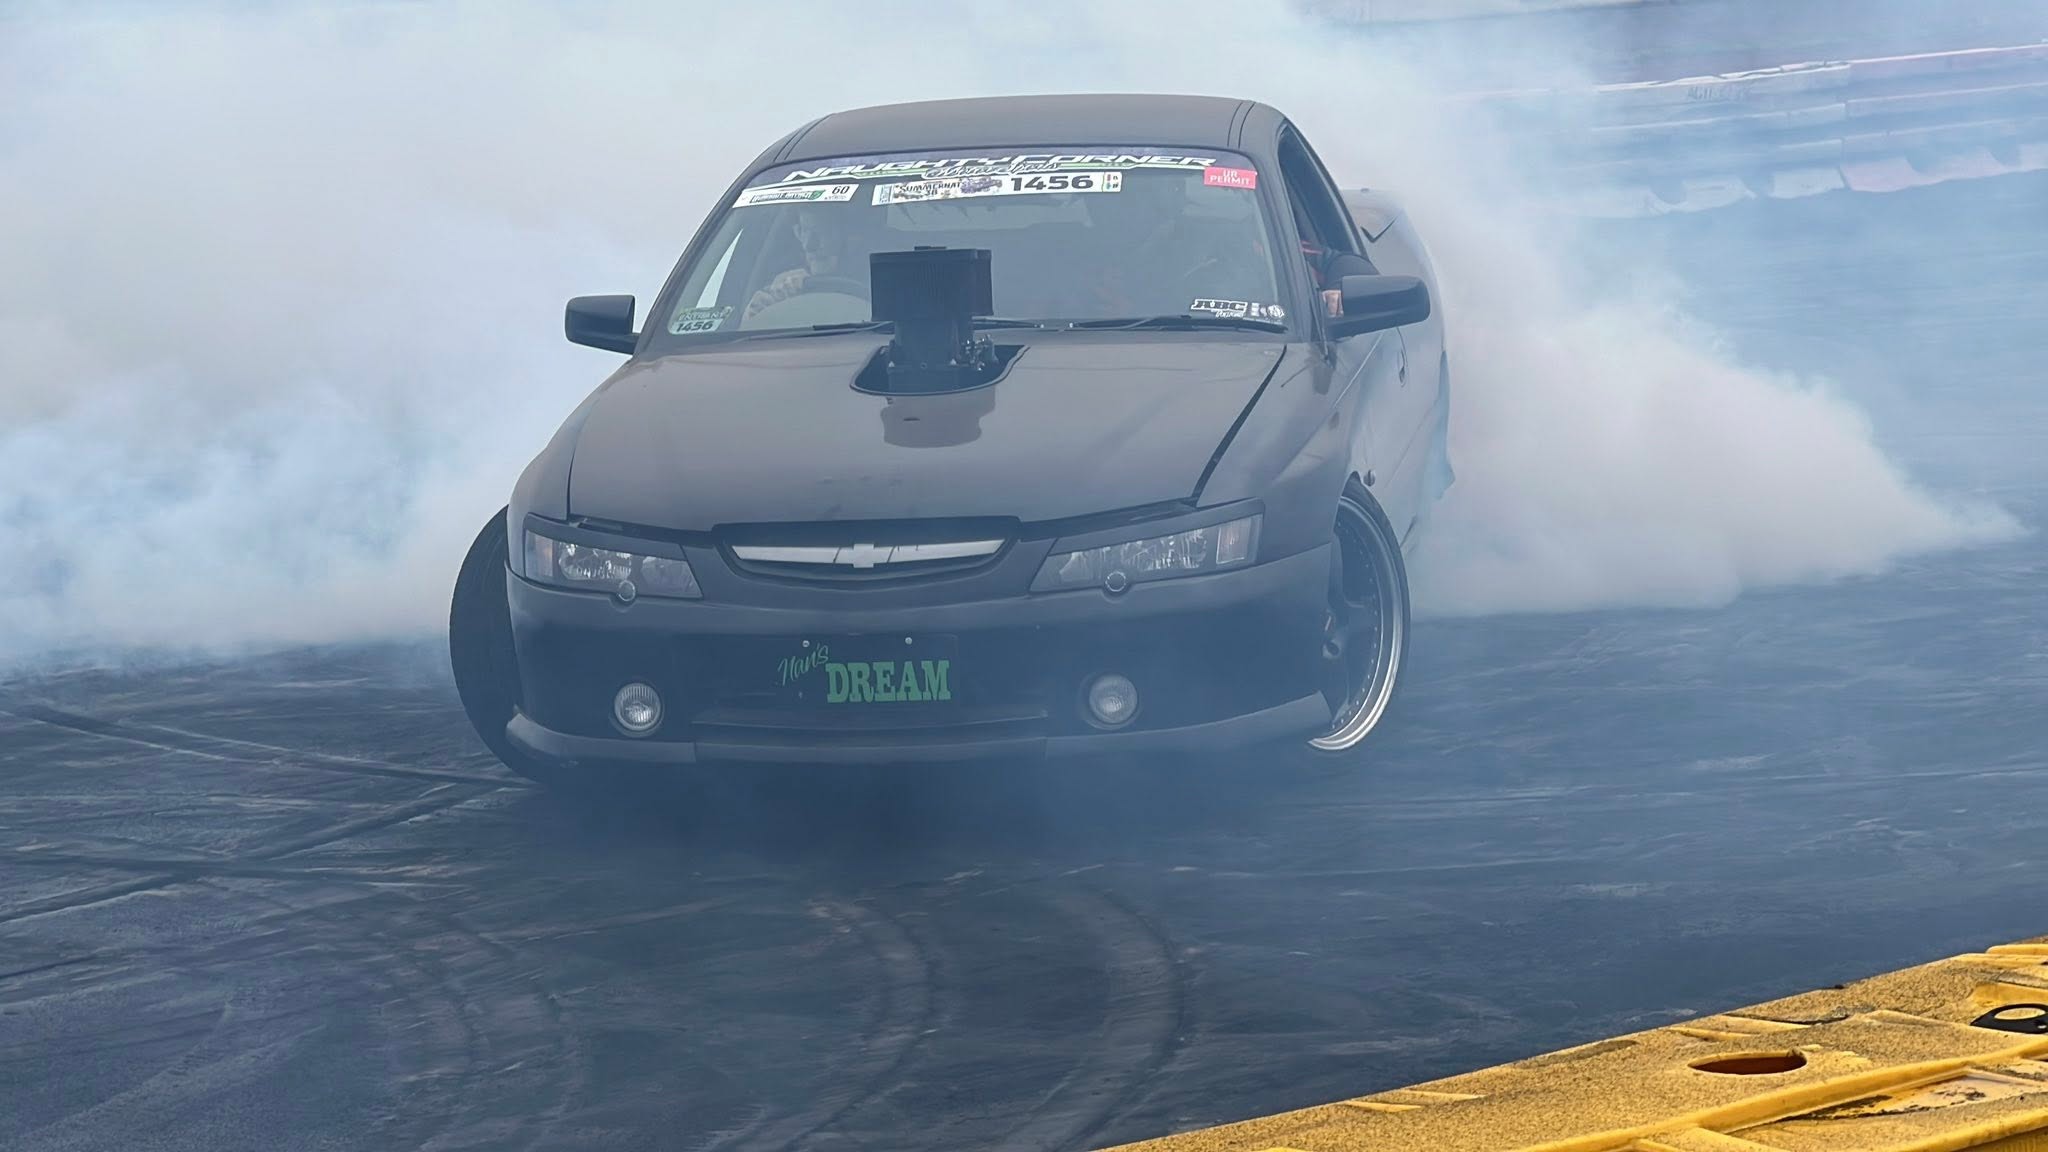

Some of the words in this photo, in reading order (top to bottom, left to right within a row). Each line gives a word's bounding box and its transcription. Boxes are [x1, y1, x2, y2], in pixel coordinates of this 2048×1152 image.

[781, 158, 1010, 182] NAUGHTY
[1010, 175, 1094, 192] 1456
[1209, 175, 1249, 187] PERMIT
[832, 185, 849, 195] 60
[677, 321, 713, 332] 1456
[777, 643, 829, 686] Nan's
[825, 660, 952, 703] DREAM
